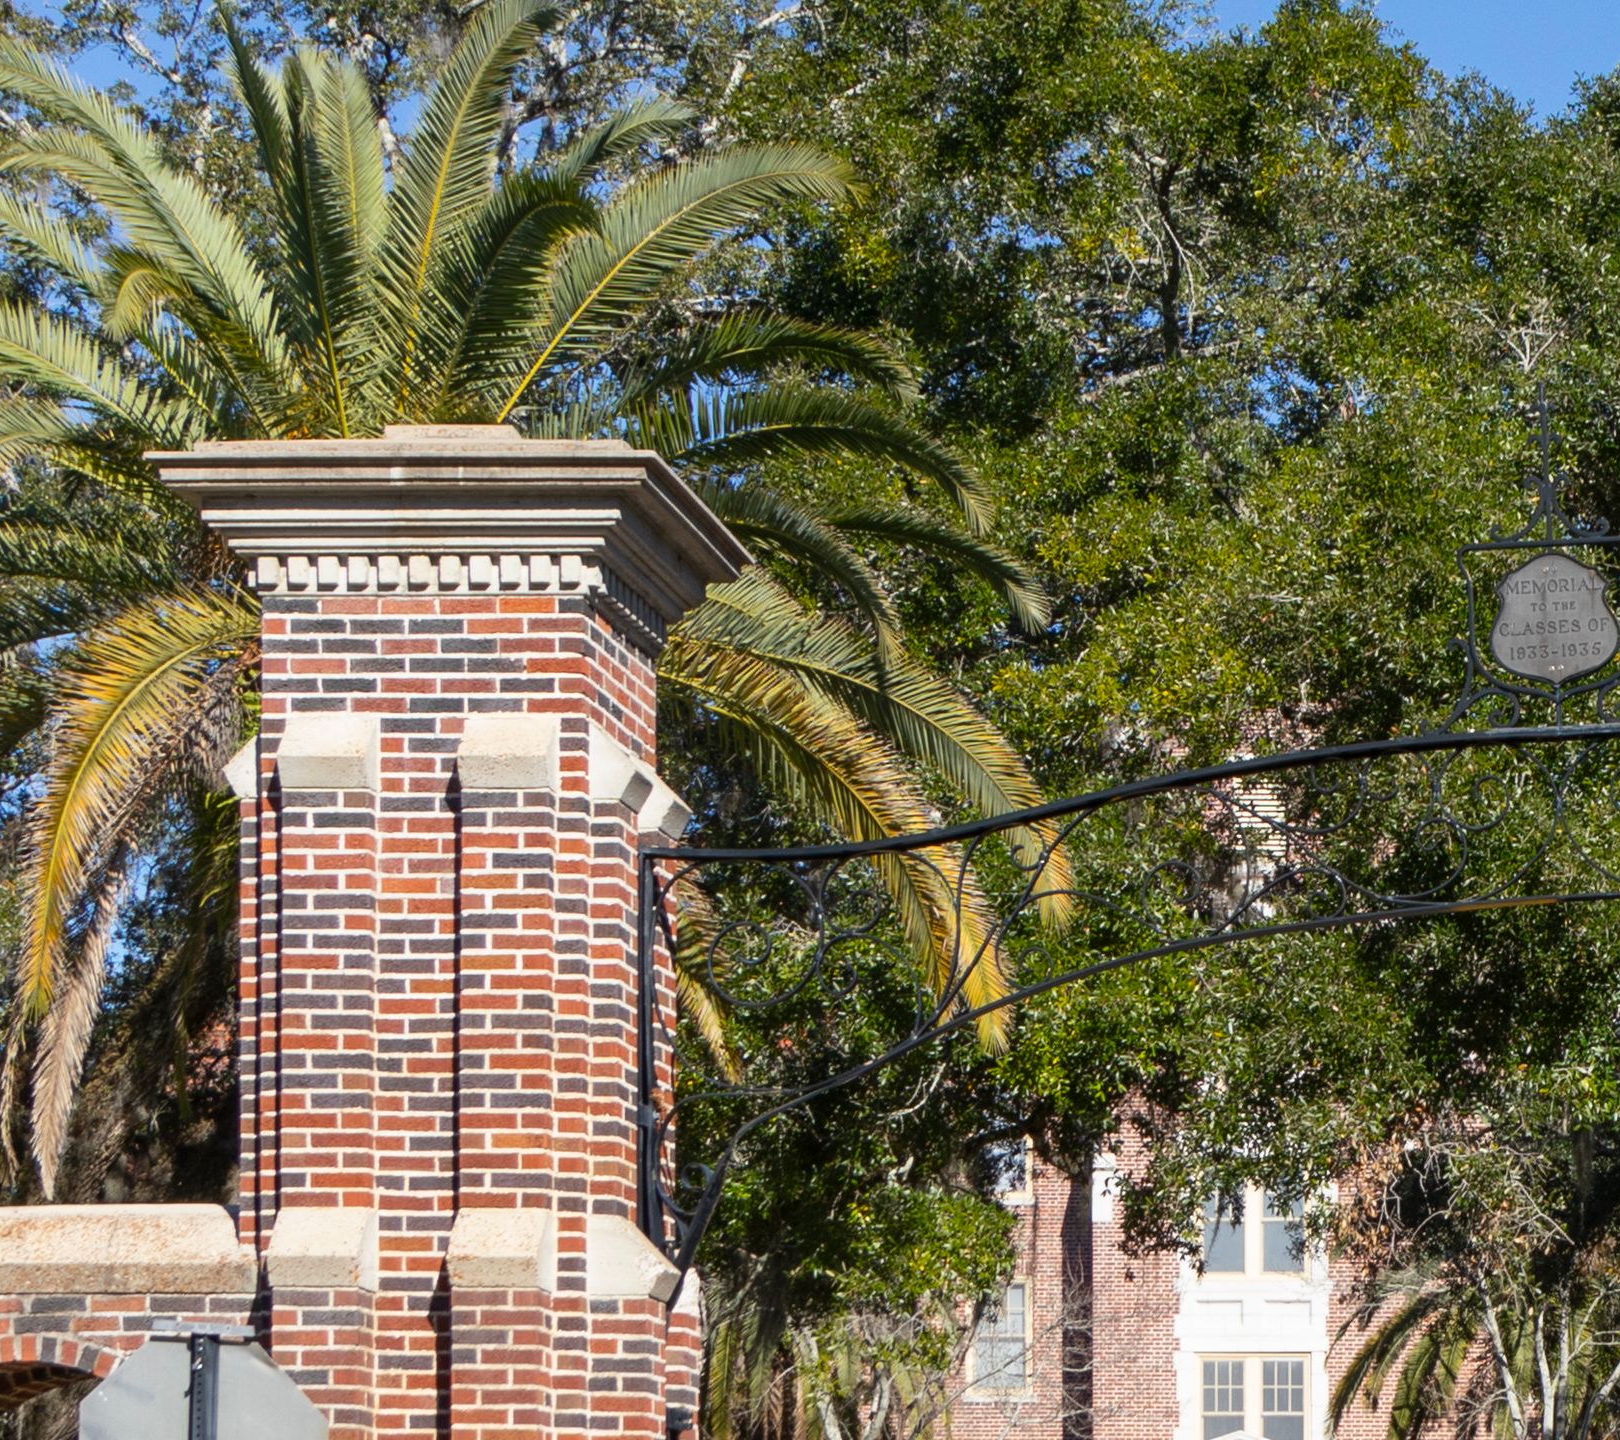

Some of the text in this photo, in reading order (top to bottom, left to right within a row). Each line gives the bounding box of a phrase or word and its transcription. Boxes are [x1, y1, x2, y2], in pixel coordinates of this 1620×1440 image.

[1506, 578, 1602, 595] MEMORIAL
[1531, 601, 1576, 612] TO THE
[1499, 618, 1609, 637] CLASSES OF
[1510, 642, 1601, 660] 1933-1935
